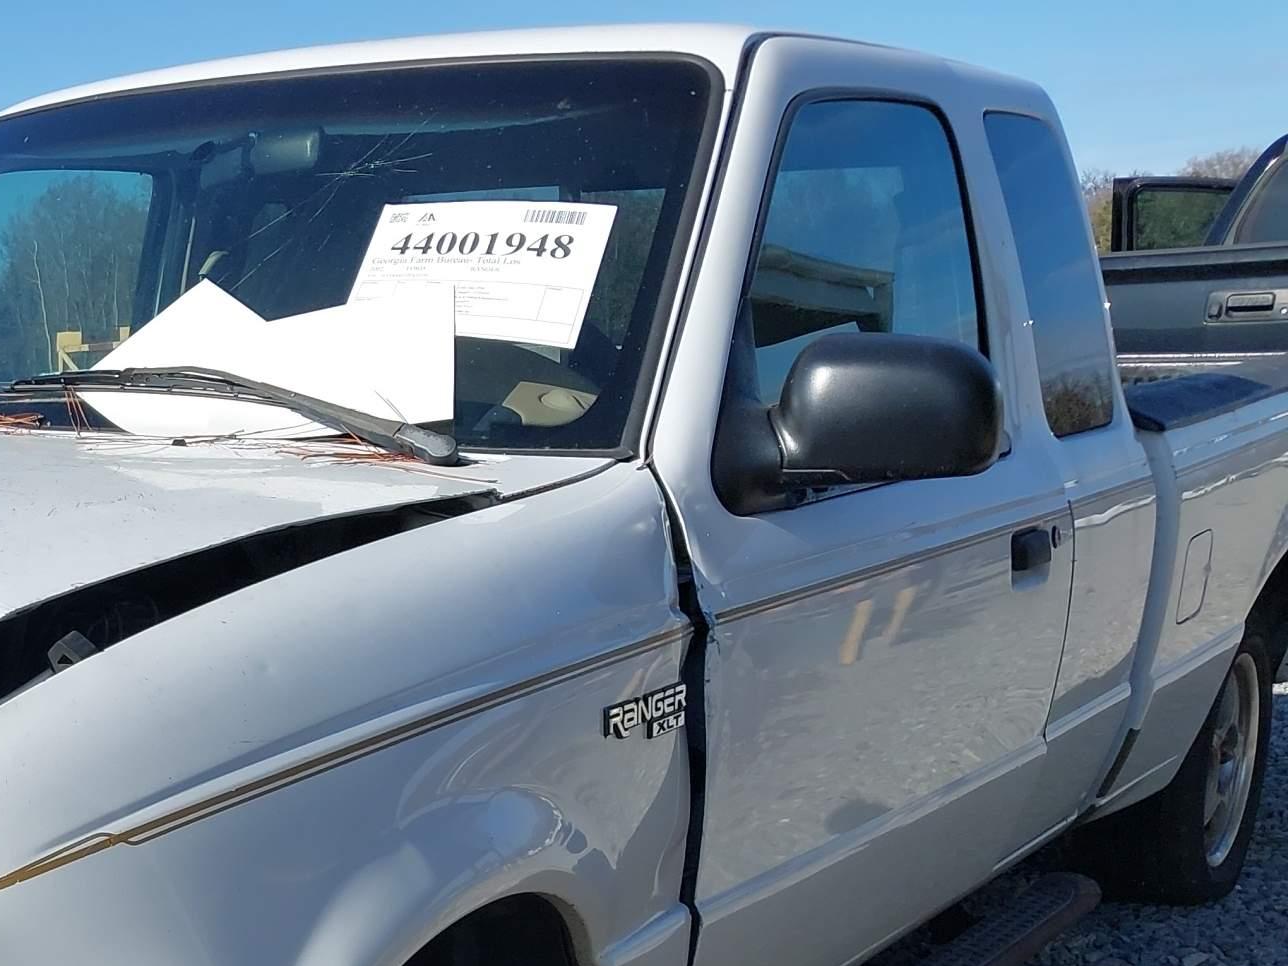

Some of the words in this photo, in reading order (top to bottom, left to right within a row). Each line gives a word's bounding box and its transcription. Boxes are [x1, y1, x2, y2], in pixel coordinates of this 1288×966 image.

[391, 231, 575, 260] 44001948
[410, 256, 434, 264] Farm
[477, 256, 501, 265] Total
[608, 683, 687, 737] RANGER
[655, 712, 684, 735] XLT
